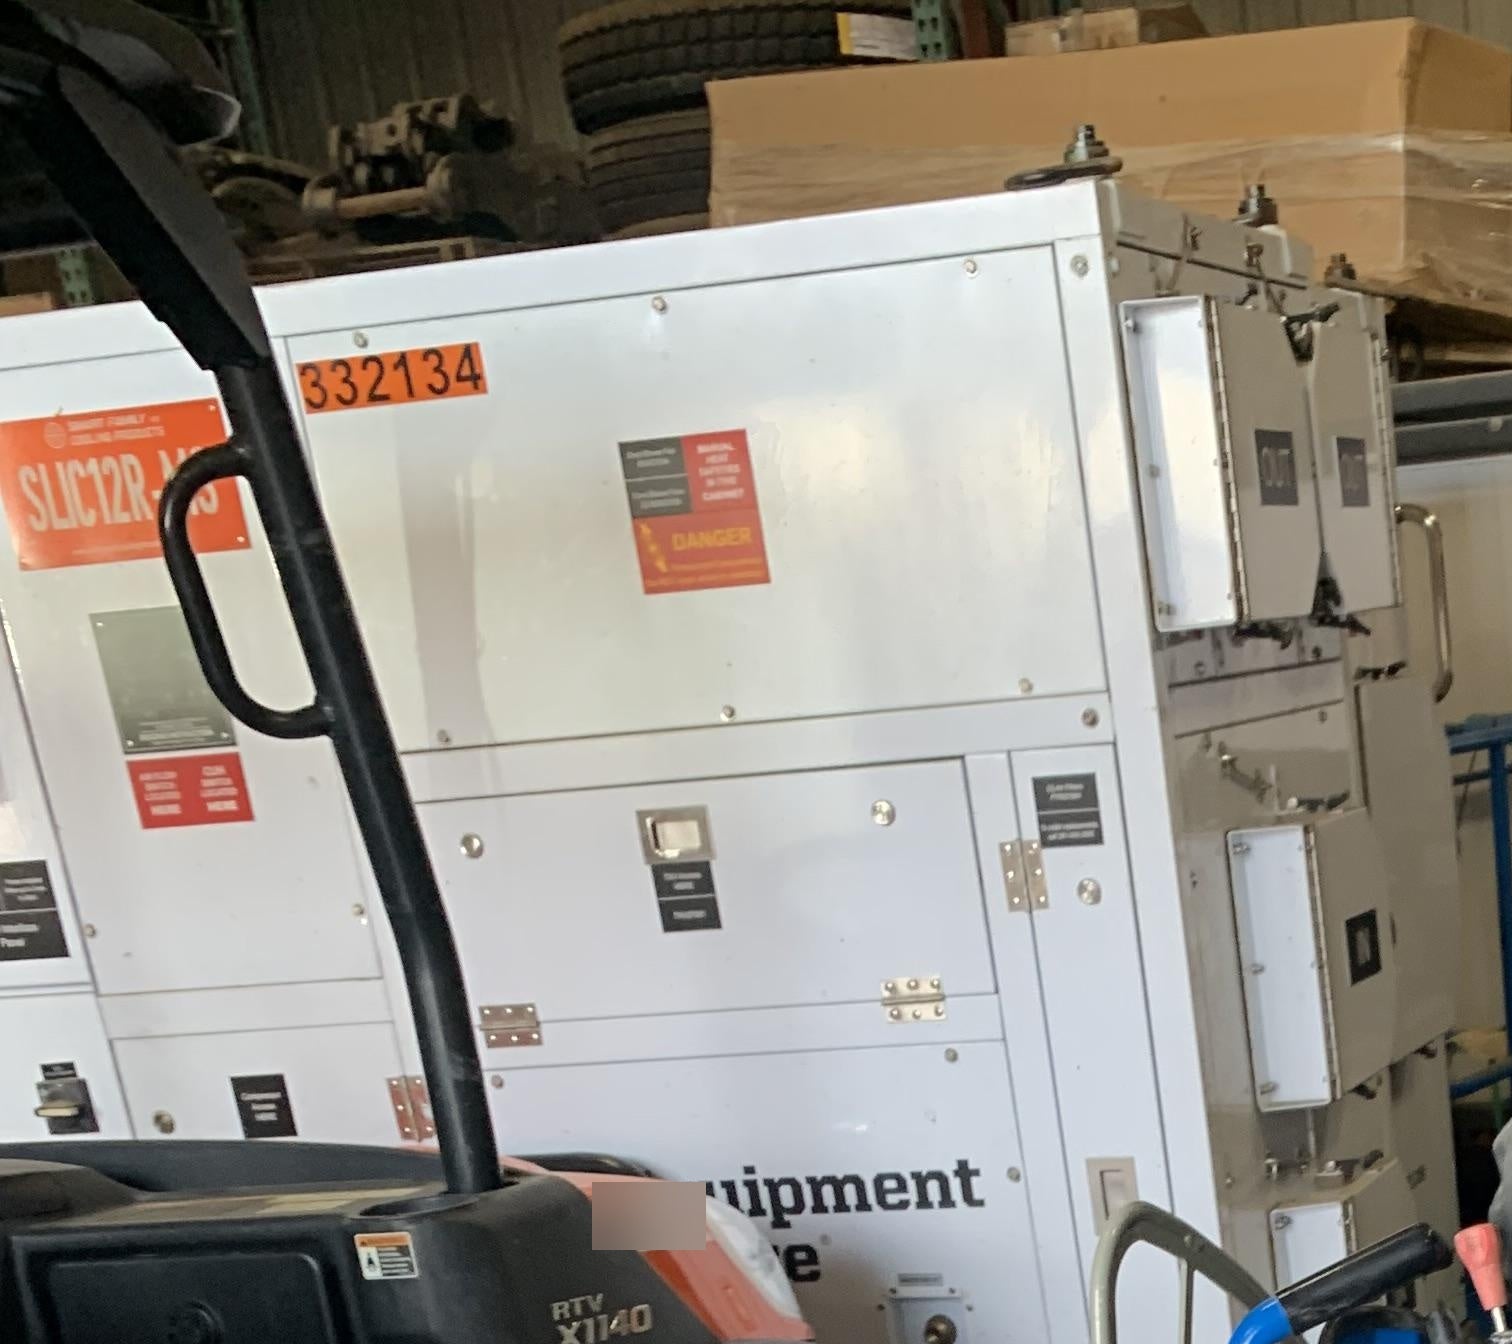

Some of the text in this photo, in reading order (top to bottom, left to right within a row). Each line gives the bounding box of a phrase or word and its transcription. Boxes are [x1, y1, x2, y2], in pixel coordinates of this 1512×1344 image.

[300, 344, 481, 409] 332134
[671, 527, 752, 551] DANGER
[551, 1293, 603, 1320] RTV
